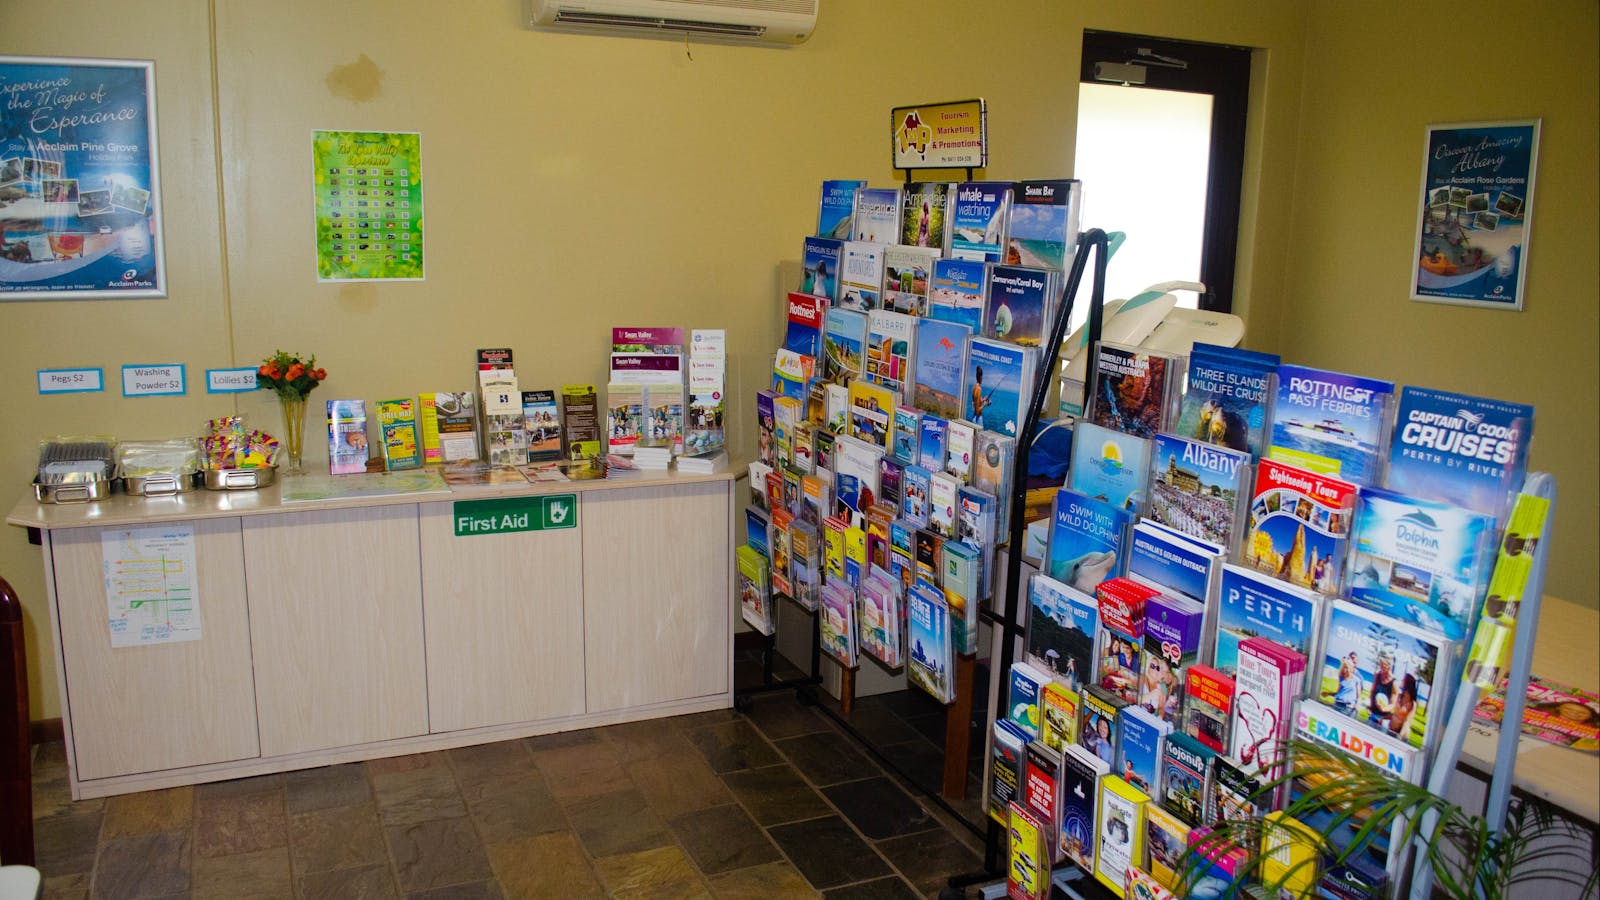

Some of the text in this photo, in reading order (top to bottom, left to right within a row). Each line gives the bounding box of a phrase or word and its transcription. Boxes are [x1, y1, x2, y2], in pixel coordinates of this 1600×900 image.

[8, 84, 106, 110] the Magic of
[31, 106, 138, 138] Esperance
[940, 111, 969, 120] Tourism
[937, 126, 974, 135] Marketing
[37, 143, 78, 152] Acclaim
[82, 142, 105, 151] Pine
[107, 143, 138, 152] Grove
[932, 140, 981, 150] & Promotions
[1435, 134, 1523, 160] Discover Amazing
[1451, 151, 1505, 174] Albany
[1451, 176, 1475, 184] Acclaim
[959, 187, 982, 202] whale
[860, 202, 896, 216] Esperance
[958, 203, 991, 220] watching
[1032, 280, 1044, 290] Bay
[790, 302, 815, 320] Rottnest
[624, 331, 652, 340] Swan Valley
[628, 358, 641, 366] Valley
[51, 374, 85, 384] Pegs $2
[134, 368, 171, 378] Washing
[213, 375, 255, 385] Lollies $2
[1196, 367, 1267, 391] THREE ISLANDS
[135, 380, 180, 391] Powder $2
[1191, 378, 1233, 397] WILDLIFE
[1289, 377, 1374, 404] ROTTNEST
[1321, 398, 1371, 418] FERRIES
[1409, 390, 1522, 414] PERTH FREMANTLE SWAN VALLEY
[1409, 409, 1515, 441] CAPTAIN COOK
[1401, 422, 1512, 465] CRUISES
[1182, 442, 1241, 480] Albany
[1402, 448, 1505, 478] PERTH BY RIVER
[1269, 467, 1339, 499] Sightseeing Tours
[458, 513, 529, 532] First Aid
[1069, 503, 1114, 528] SWIM WITH
[1058, 511, 1120, 545] WILD DOLPHINS
[1395, 523, 1440, 550] Dolphin
[1135, 538, 1207, 575] AUSTRALIA'S GOLDEN OUTBACK
[1073, 606, 1089, 619] WEST
[1228, 587, 1304, 632] PERTH
[1296, 711, 1404, 774] GERALDTON
[1165, 740, 1204, 773] Kojonup
